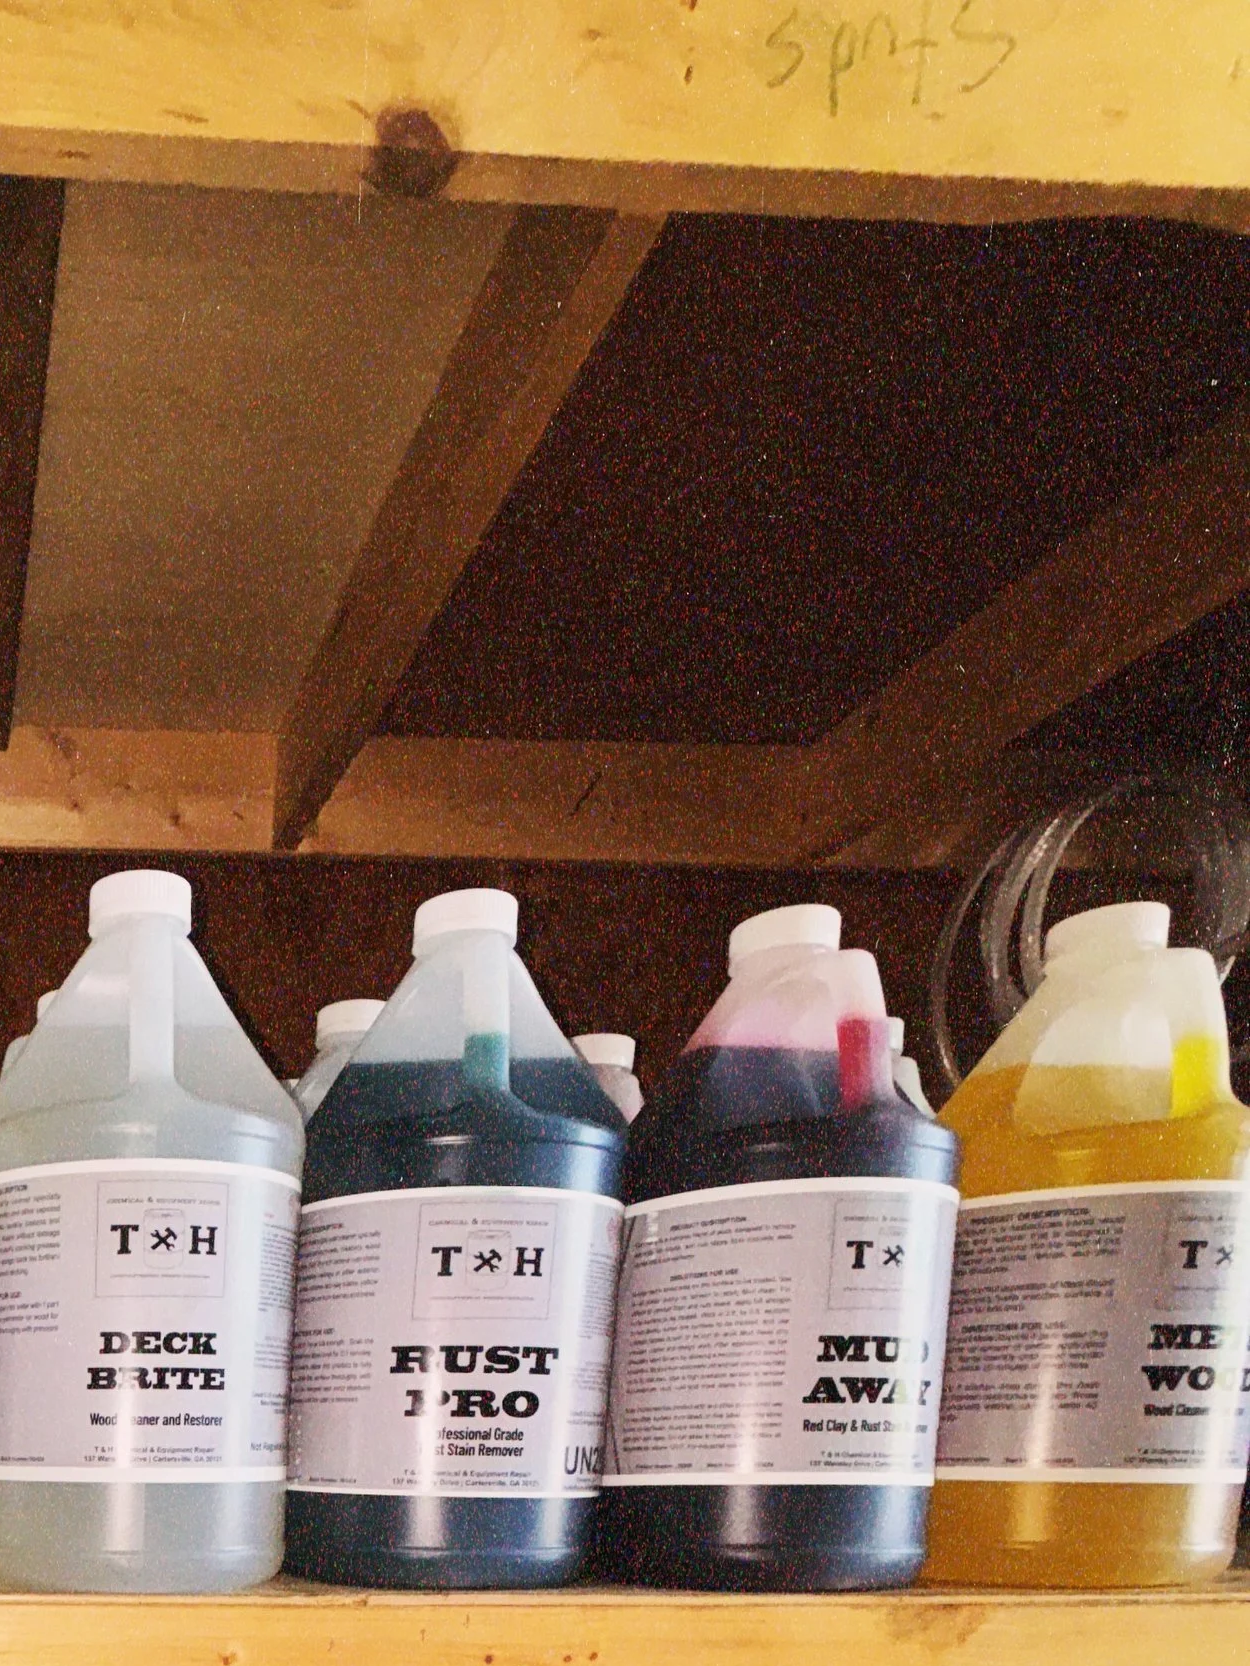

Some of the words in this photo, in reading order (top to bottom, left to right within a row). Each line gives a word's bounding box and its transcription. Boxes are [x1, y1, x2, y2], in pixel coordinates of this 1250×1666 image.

[110, 1224, 139, 1255] T
[188, 1224, 218, 1256] H
[430, 1246, 462, 1277] T
[513, 1246, 545, 1278] H
[846, 1240, 874, 1269] T
[1179, 1240, 1208, 1269] T
[99, 1331, 217, 1355] DECK
[1147, 1323, 1235, 1350] ME
[390, 1345, 559, 1376] RUST
[86, 1367, 225, 1390] BRITE
[1141, 1365, 1250, 1392] WOD
[404, 1389, 540, 1418] PRO
[90, 1412, 118, 1426] Wood
[128, 1413, 159, 1426] eaner
[162, 1412, 181, 1426] and
[183, 1413, 223, 1427] Restorer
[803, 1418, 824, 1432] Red
[826, 1418, 848, 1435] Clay
[850, 1419, 858, 1432] &
[860, 1419, 881, 1432] Rust
[436, 1426, 492, 1441] ofessional
[493, 1428, 524, 1441] Grade
[447, 1443, 475, 1456] Stain
[478, 1444, 524, 1457] Remover
